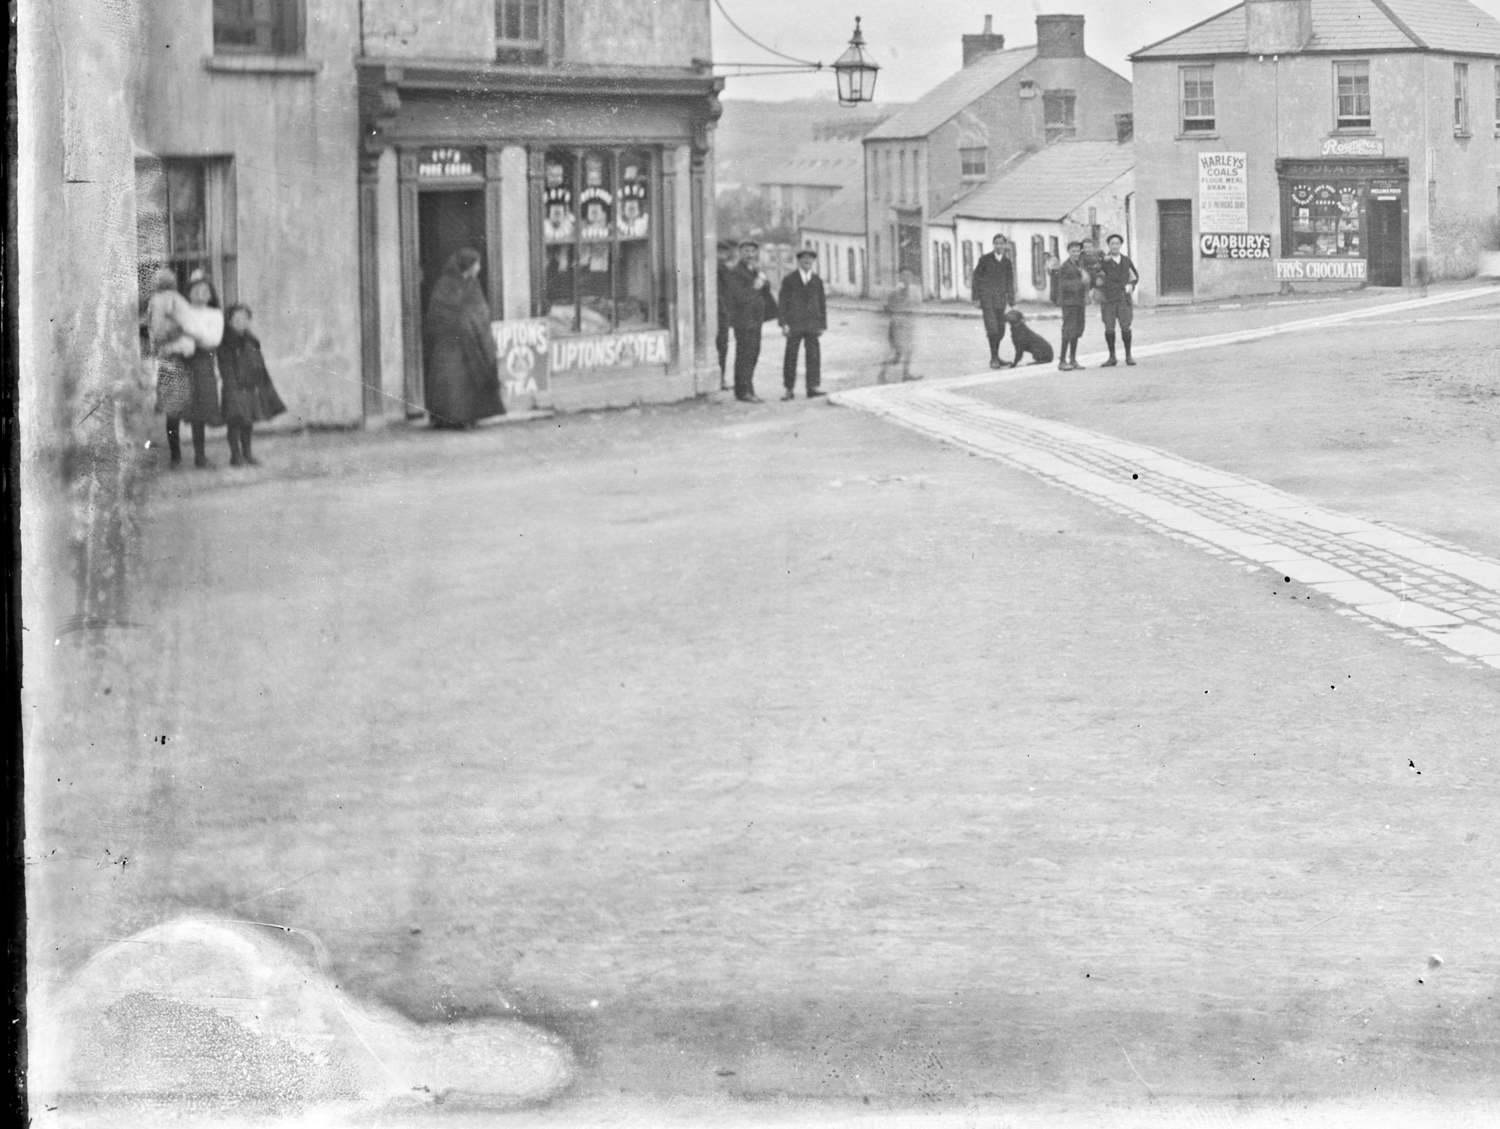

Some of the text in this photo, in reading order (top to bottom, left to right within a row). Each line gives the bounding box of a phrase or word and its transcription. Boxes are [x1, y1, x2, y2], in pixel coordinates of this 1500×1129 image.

[1207, 168, 1239, 177] COALS
[1230, 248, 1270, 258] COCOA
[1306, 262, 1365, 278] CHOCOLATE
[636, 333, 667, 363] TEA
[505, 376, 539, 397] TEA
